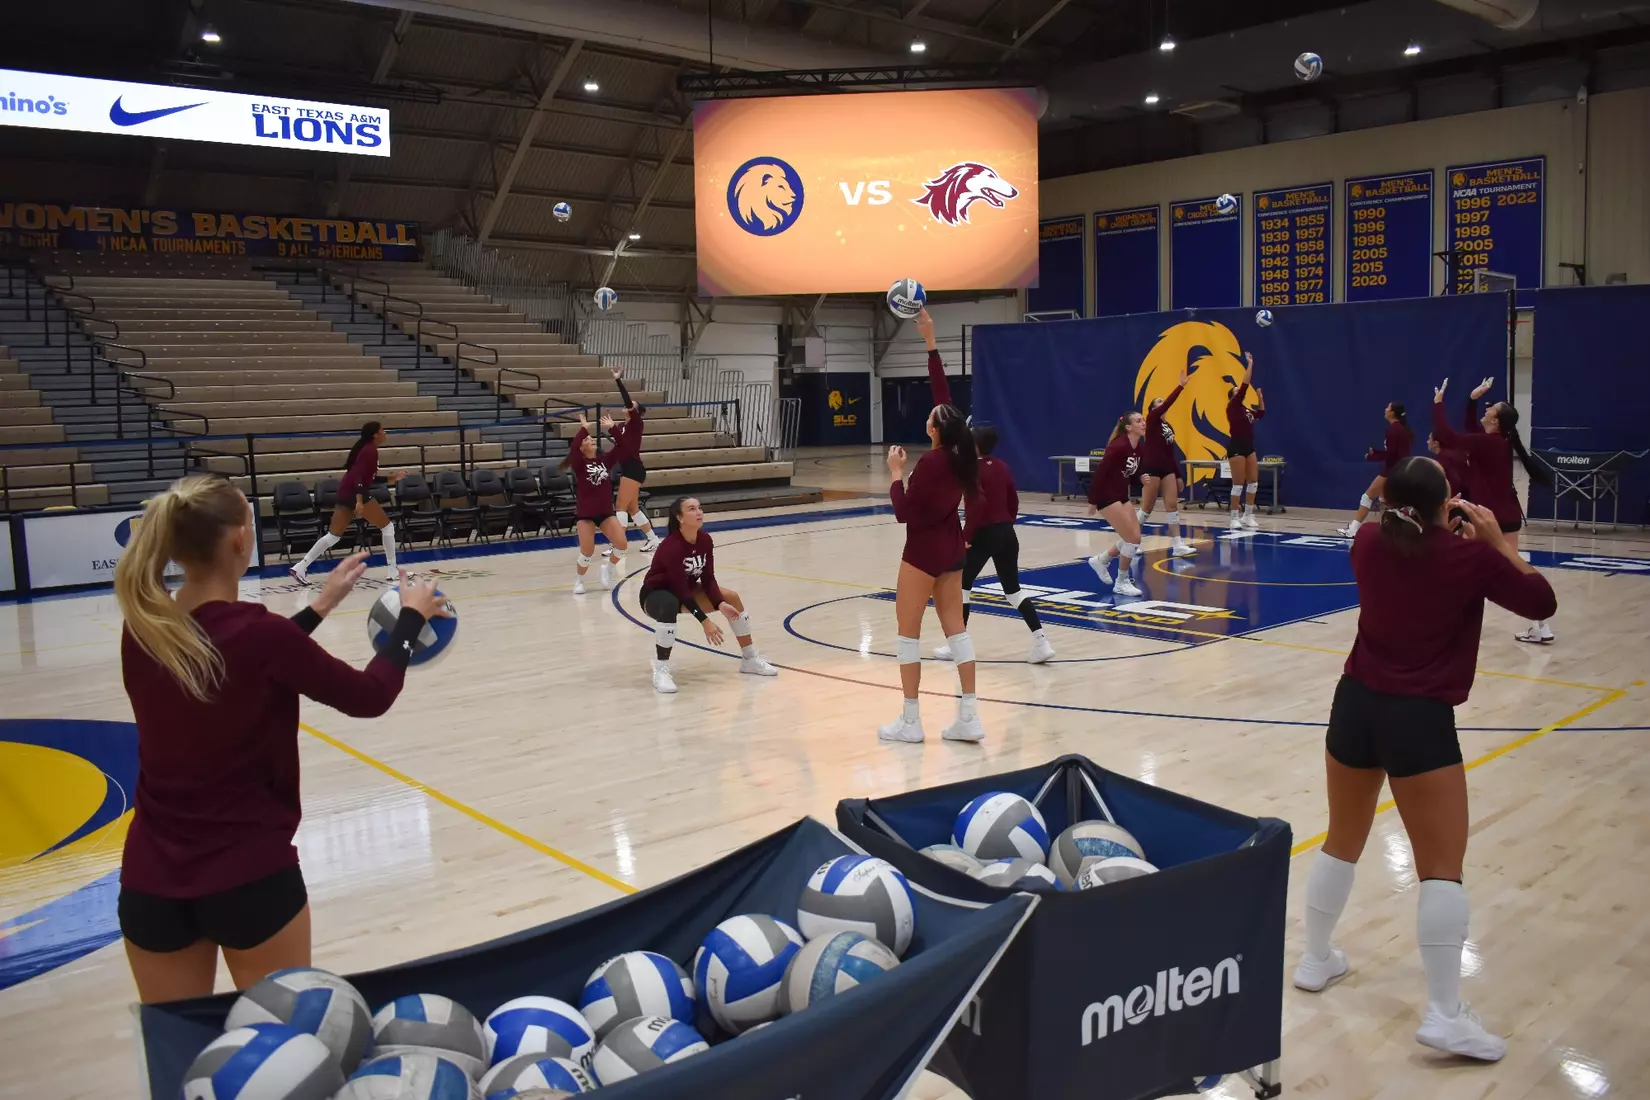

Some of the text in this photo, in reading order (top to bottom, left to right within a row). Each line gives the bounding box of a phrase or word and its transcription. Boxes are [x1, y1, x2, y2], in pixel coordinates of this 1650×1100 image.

[252, 103, 381, 124] EAST TEXAS A&M
[252, 113, 382, 147] LIONS
[1486, 166, 1523, 177] MEN'S
[1381, 178, 1415, 189] MEN'S
[1469, 172, 1540, 186] BASKETBALL
[838, 179, 894, 206] VS
[1285, 190, 1315, 201] MEN'S
[1365, 184, 1429, 197] BASKETBALL
[1453, 182, 1537, 198] NCAA TOURNAMENT
[1271, 195, 1329, 208] BASKETBALL
[1456, 191, 1537, 210] 1996 2022
[1353, 207, 1386, 220] 1990
[1455, 211, 1490, 224] 1997
[1261, 214, 1325, 230] 1934 1955
[1353, 221, 1385, 233] 1996
[192, 212, 416, 246] BASKETBALL
[1261, 227, 1324, 243] 1939 1957
[1455, 225, 1490, 238] 1998
[110, 235, 147, 252] NCAA
[152, 237, 246, 256] TOURNAMENTS
[1353, 234, 1385, 246] 1998
[1454, 239, 1493, 252] 2005
[278, 241, 287, 257] 9
[1261, 240, 1324, 256] 1940 1958
[1352, 248, 1388, 260] 2005
[1261, 253, 1325, 268] 1942 1964
[1457, 253, 1489, 266] 015
[1261, 266, 1324, 281] 1948 1974
[1352, 261, 1384, 273] 2015
[1261, 279, 1324, 293] 1950 1977
[1352, 274, 1387, 287] 2020
[1457, 282, 1489, 295] 208
[1261, 292, 1324, 306] 1953 1978
[1557, 455, 1590, 465] molten
[92, 558, 119, 570] EAS
[1081, 955, 1241, 1046] molten
